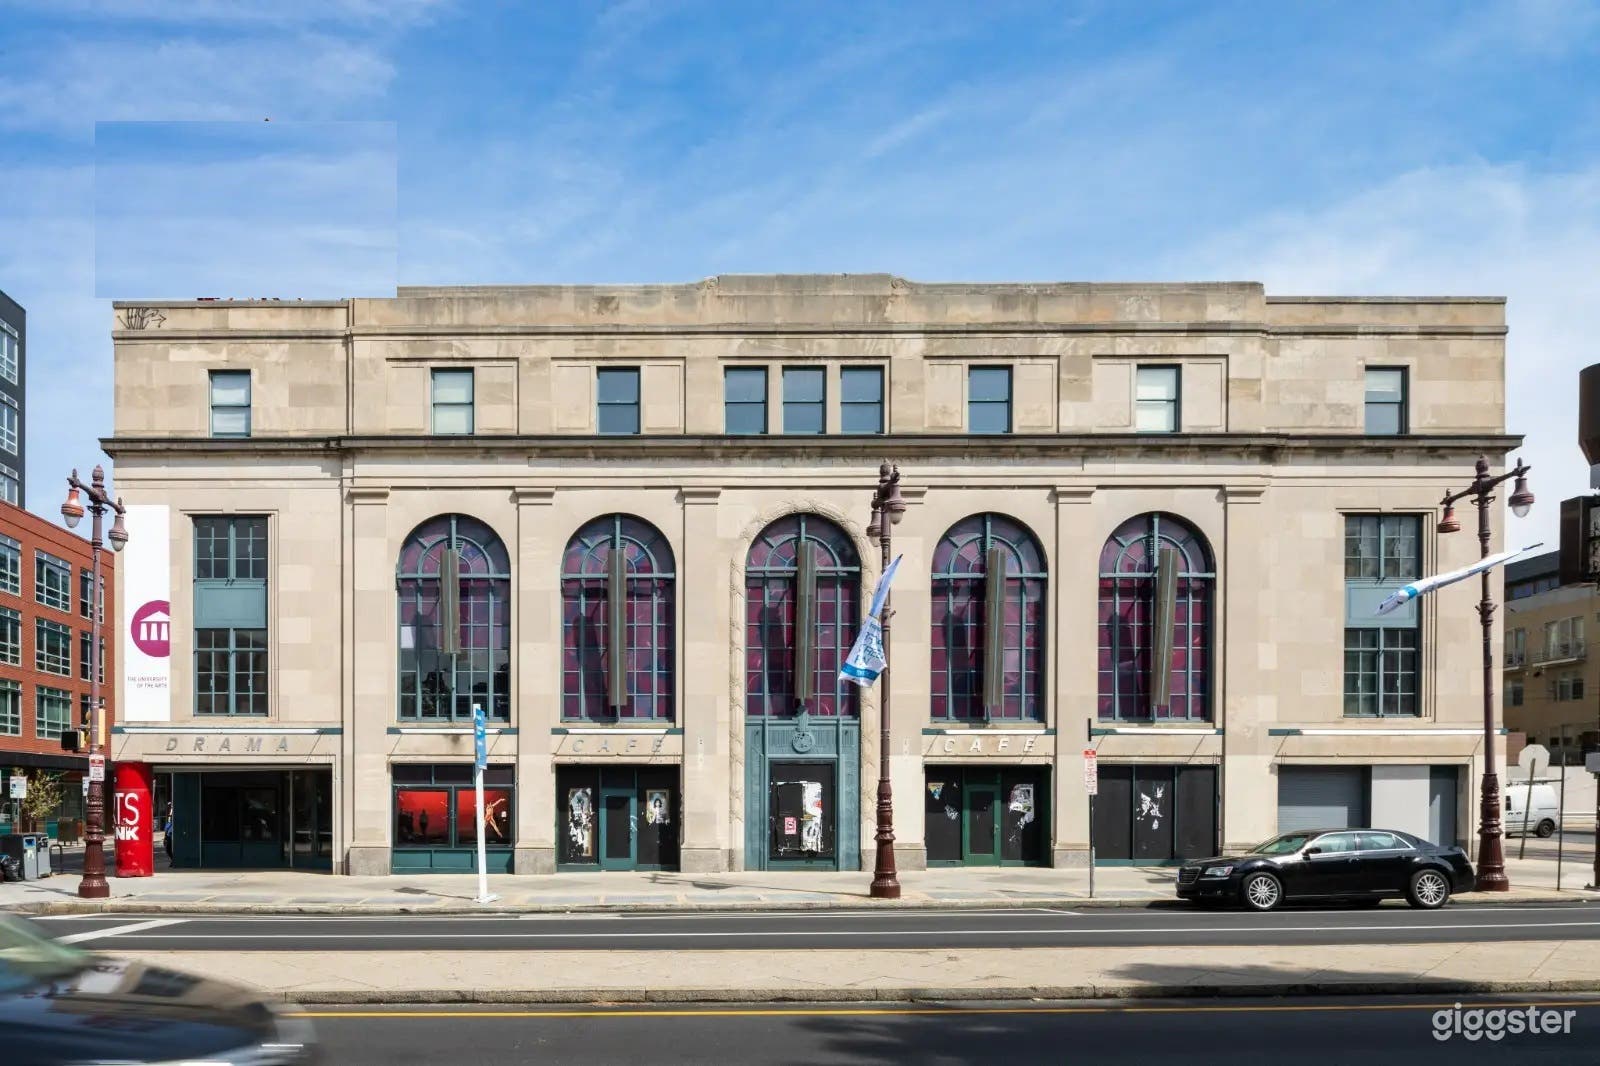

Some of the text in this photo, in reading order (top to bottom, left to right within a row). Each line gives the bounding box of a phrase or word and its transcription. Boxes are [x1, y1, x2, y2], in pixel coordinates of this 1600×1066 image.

[166, 736, 288, 752] DRAMA
[572, 739, 663, 753] CAFE
[943, 738, 1034, 753] CAFE
[113, 792, 139, 826] TS
